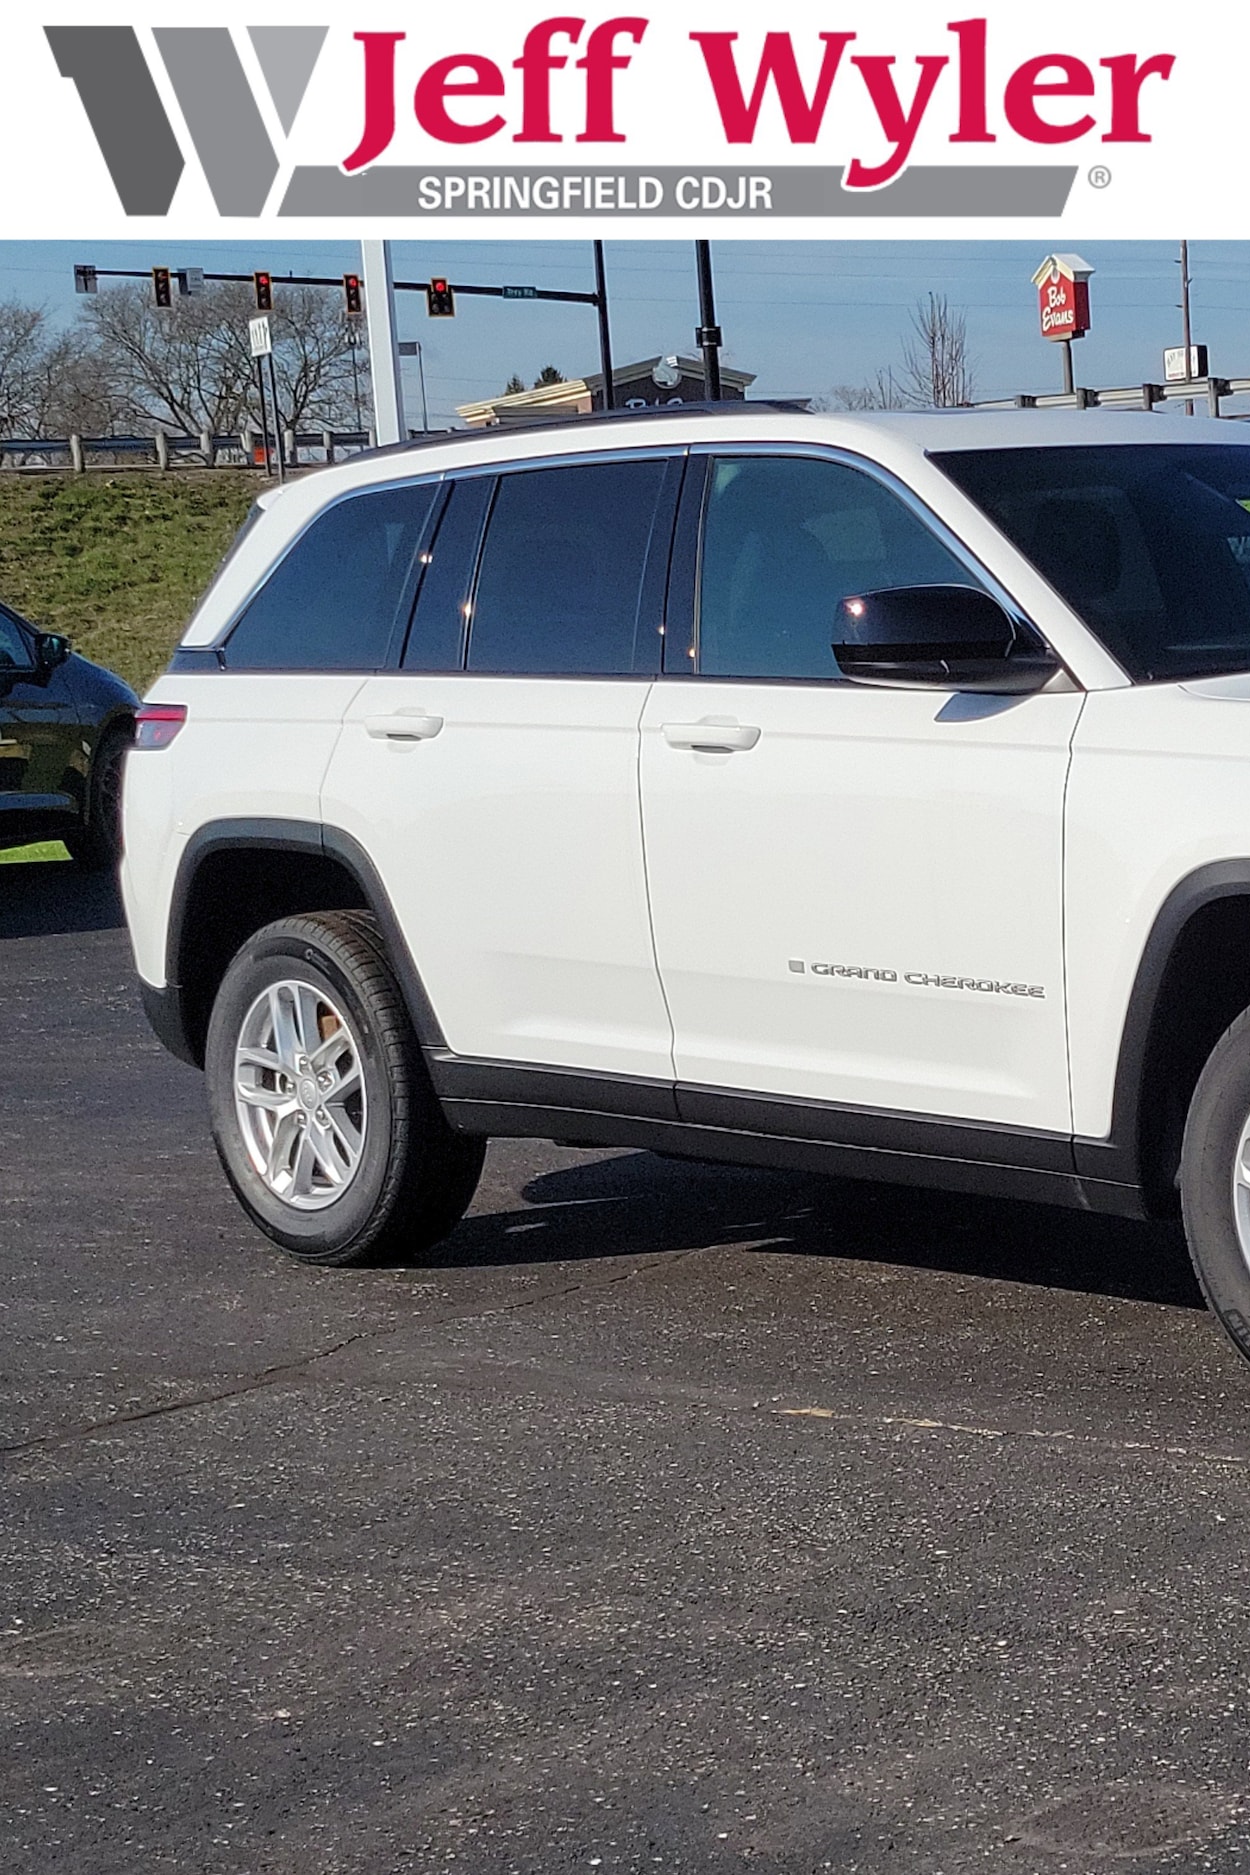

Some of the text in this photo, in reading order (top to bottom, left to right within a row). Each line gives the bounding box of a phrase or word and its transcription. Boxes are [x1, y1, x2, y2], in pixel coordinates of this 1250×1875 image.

[1048, 286, 1067, 308] Bob
[1042, 306, 1074, 332] Evans
[811, 961, 1046, 999] GRAND CHEROKEE
